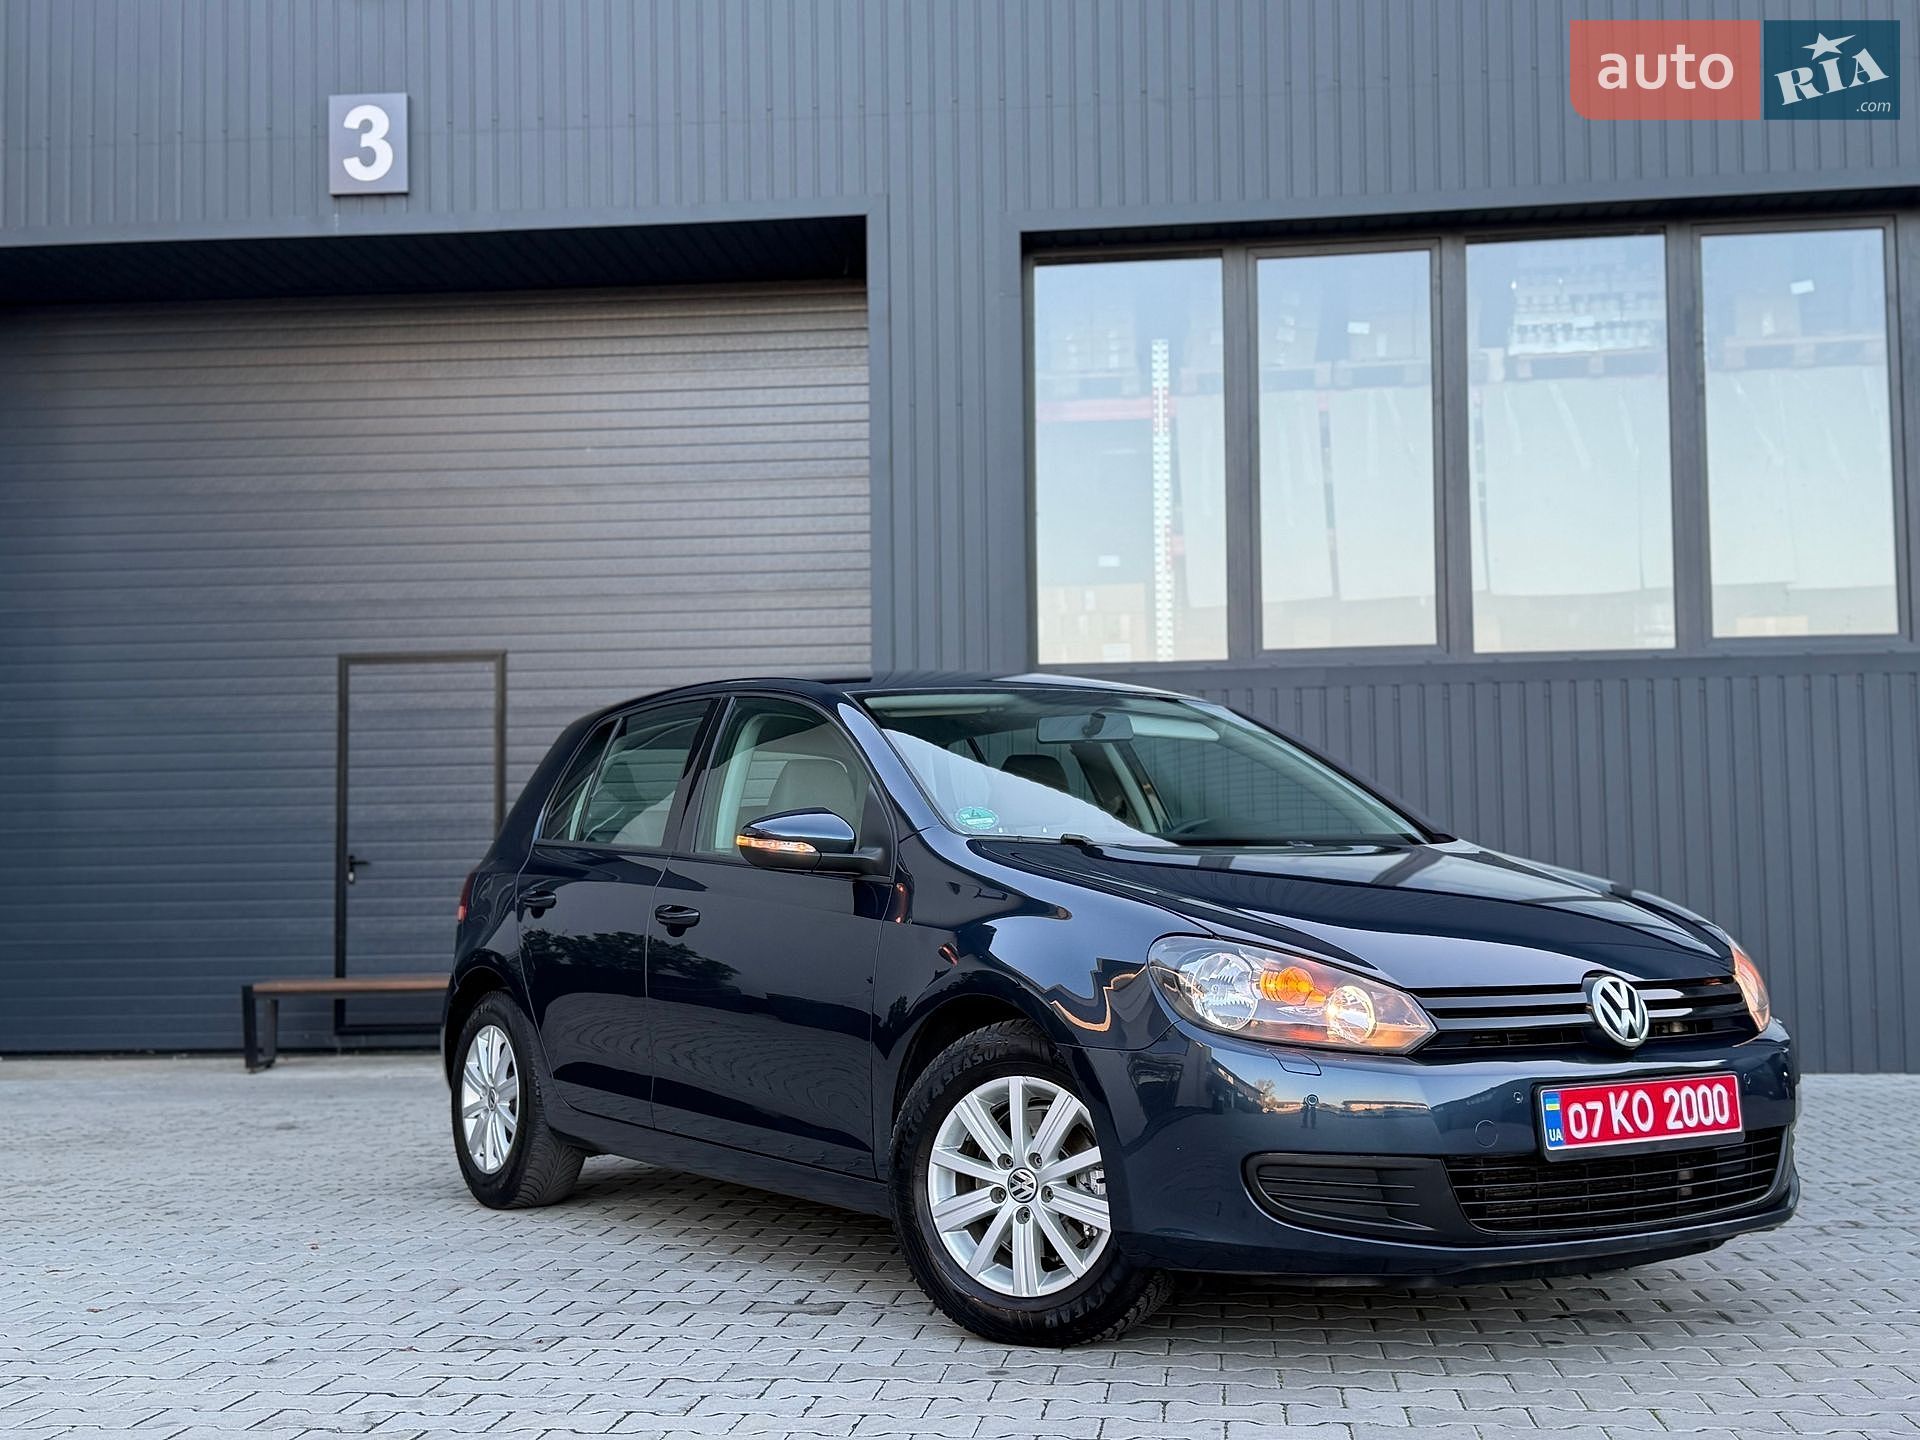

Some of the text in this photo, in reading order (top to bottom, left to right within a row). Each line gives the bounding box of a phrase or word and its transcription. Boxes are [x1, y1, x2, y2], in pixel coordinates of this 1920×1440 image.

[343, 104, 393, 181] 3
[1663, 1083, 1730, 1131] 2000
[1549, 1129, 1563, 1141] UA
